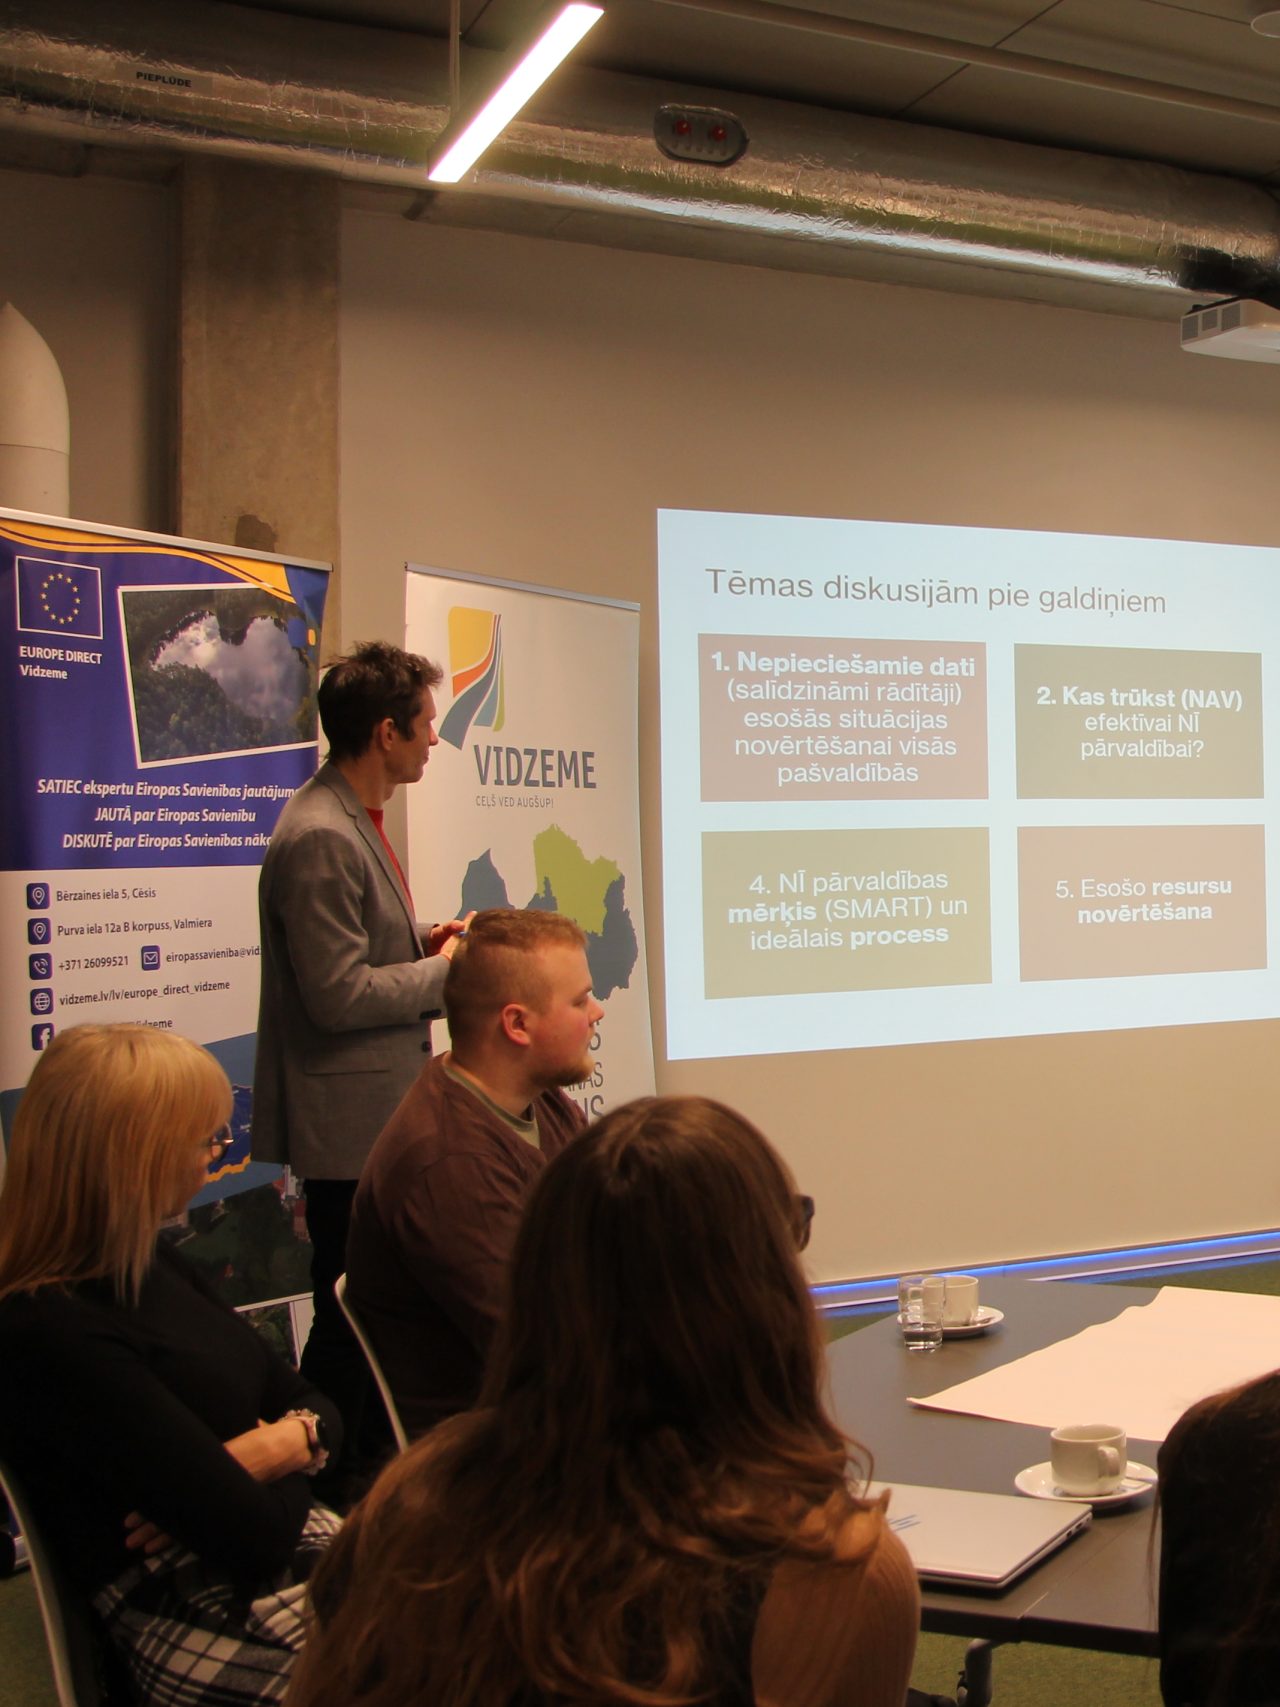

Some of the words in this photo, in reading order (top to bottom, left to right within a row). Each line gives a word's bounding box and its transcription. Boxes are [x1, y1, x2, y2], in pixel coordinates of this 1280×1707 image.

[705, 568, 813, 598] Tēmas
[824, 575, 978, 608] diskusijām
[989, 583, 1029, 610] pie
[1038, 584, 1166, 617] galdiņiem
[20, 646, 64, 661] EUROPE
[66, 650, 102, 664] DIRECT
[712, 652, 730, 671] 1.
[738, 652, 923, 676] Nepieciešamie
[930, 657, 975, 677] dati
[20, 664, 68, 679] Vidzeme
[727, 678, 871, 702] (salīdzināmi
[877, 683, 962, 705] rādītāji)
[1037, 686, 1056, 705] 2.
[1063, 686, 1105, 706] Kas
[1110, 688, 1175, 707] trūkst
[1181, 689, 1243, 711] (NAV)
[744, 709, 831, 729] esošās
[840, 710, 948, 733] situācijas
[1085, 713, 1171, 732] efektīvai
[1178, 712, 1200, 732] NĪ
[735, 735, 892, 756] novērtēšanai
[900, 737, 957, 755] visās
[1081, 738, 1204, 760] pārvaldībai?
[474, 745, 597, 789] VIDZEME
[778, 763, 919, 786] pašvaldībās
[37, 779, 82, 793] SATIEC
[84, 780, 134, 798] ekspertu
[136, 782, 180, 799] Eiropas
[182, 784, 241, 797] Savienības
[242, 784, 296, 800] jautājum
[499, 796, 515, 807] VED
[95, 806, 131, 821] JAUTĀ
[134, 812, 155, 825] par
[158, 808, 200, 825] Eiropas
[202, 808, 256, 822] Savienību
[63, 832, 113, 848] DISKUTĒ
[114, 838, 135, 851] par
[138, 834, 182, 851] Eiropas
[184, 834, 242, 847] Savienības
[750, 875, 770, 895] 4.
[780, 870, 805, 894] NĪ
[814, 870, 948, 896] pārvaldības
[1056, 880, 1074, 899] 5.
[1081, 878, 1146, 897] Esošo
[1152, 878, 1232, 896] resursu
[56, 890, 101, 901] Bērzaines
[103, 889, 119, 899] iela
[122, 890, 130, 900] 5,
[132, 888, 156, 899] Cēsis
[728, 902, 817, 927] mērķis
[825, 897, 932, 923] (SMART)
[941, 898, 968, 915] un
[1078, 903, 1212, 924] novērtēšana
[58, 926, 85, 936] Purva
[86, 924, 102, 934] iela
[105, 923, 121, 933] 12a
[124, 922, 130, 932] B
[132, 920, 172, 933] korpuss,
[174, 918, 213, 929] Valmiera
[751, 928, 843, 950] ideālais
[850, 927, 949, 950] process
[58, 960, 81, 971] +371
[84, 956, 129, 969] 26099521
[166, 946, 260, 963] eiropassavieniba@vid
[60, 981, 231, 1006] vidzeme.lv/lv/europe_direct_vidzeme
